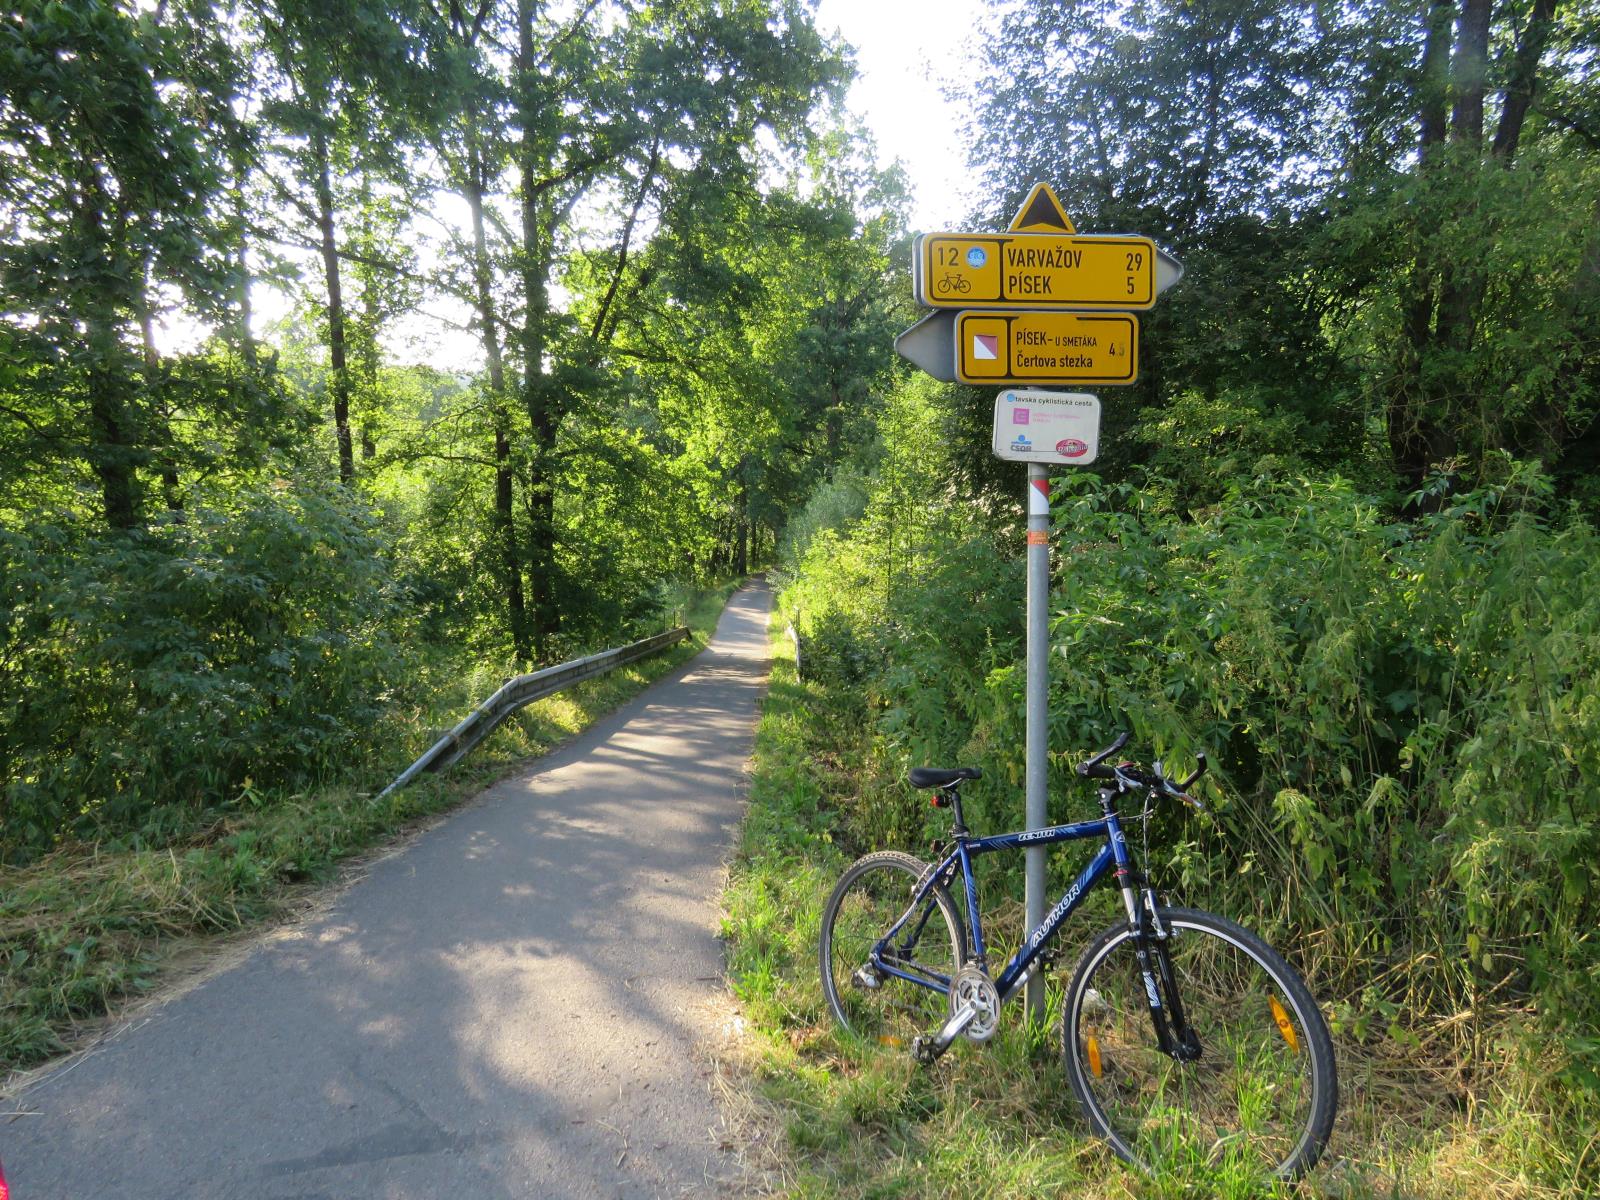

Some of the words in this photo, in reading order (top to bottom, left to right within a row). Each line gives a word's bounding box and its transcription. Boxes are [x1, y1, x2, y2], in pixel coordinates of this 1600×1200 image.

[938, 247, 959, 266] 12
[1008, 246, 1082, 268] VARVAŽOV
[1126, 253, 1143, 271] 29
[1009, 272, 1052, 294] PÍSEK
[1127, 276, 1135, 294] 5
[1055, 336, 1060, 346] U
[1062, 335, 1097, 347] SMETÁKA
[1017, 350, 1056, 367] Čertova
[1059, 354, 1093, 368] stezka
[1032, 883, 1081, 948] AUTHOR
